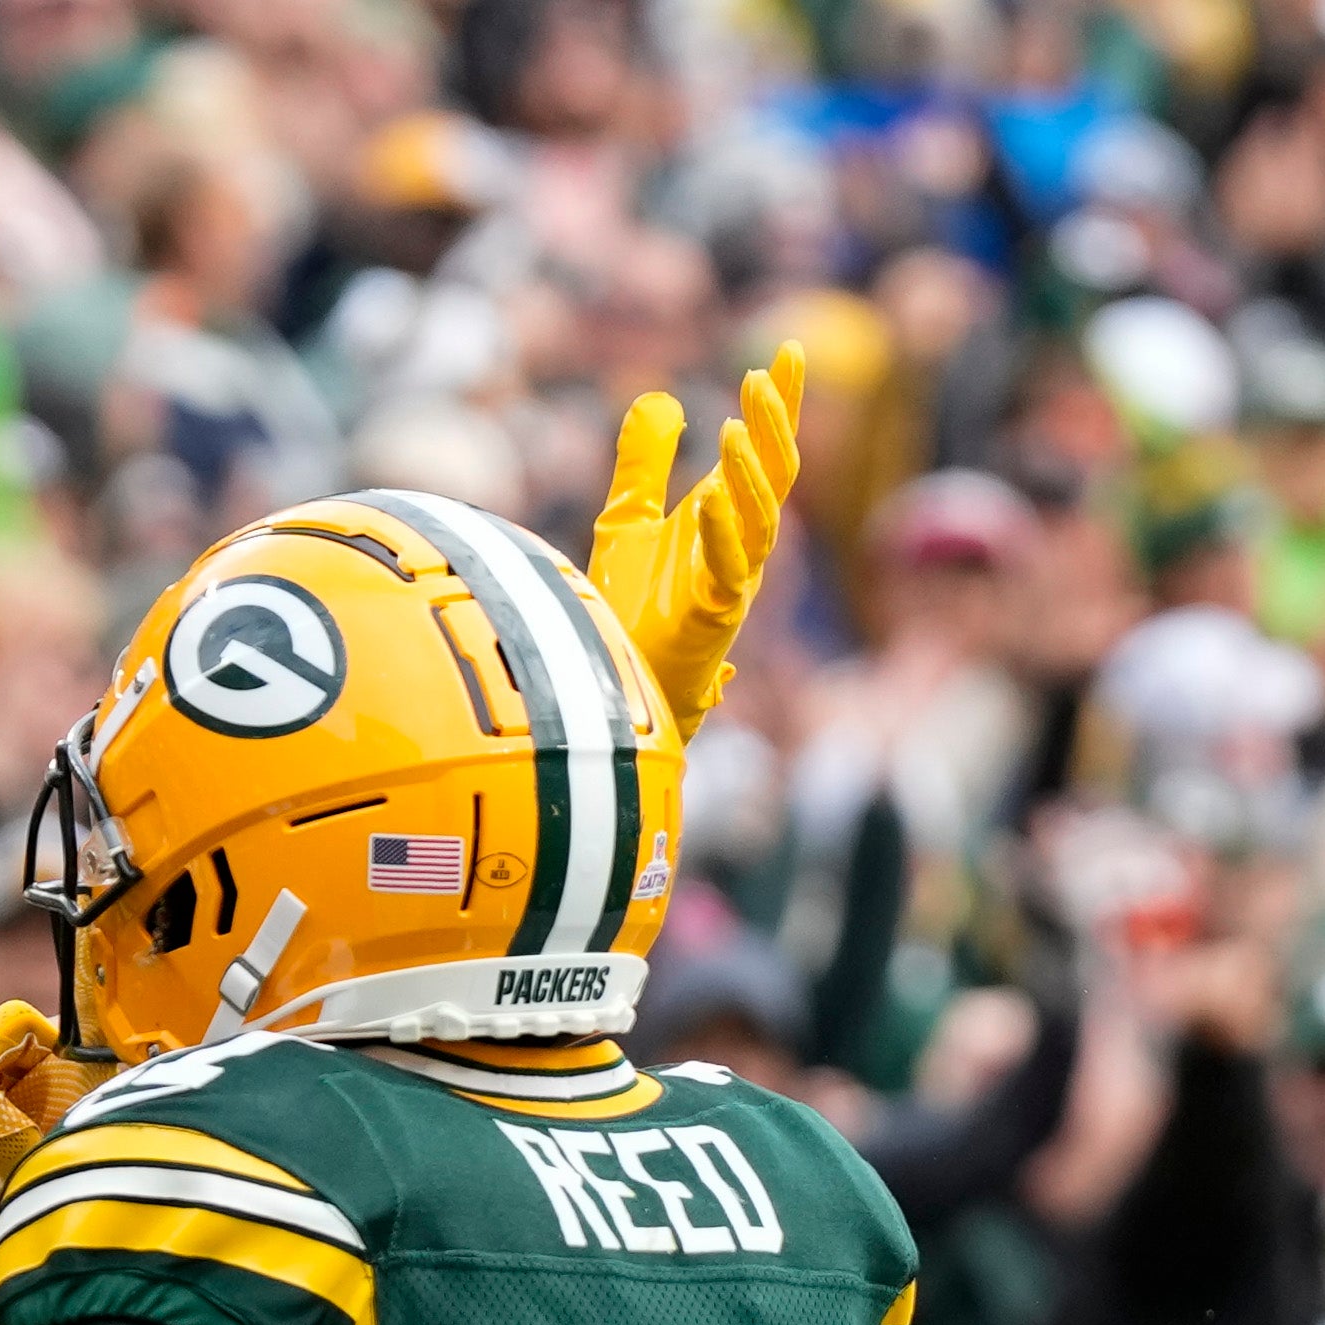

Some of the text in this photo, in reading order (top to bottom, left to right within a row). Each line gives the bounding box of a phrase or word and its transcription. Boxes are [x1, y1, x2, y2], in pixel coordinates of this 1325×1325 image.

[169, 582, 337, 729] G
[493, 964, 611, 1006] PACKERS
[491, 1119, 786, 1255] REED
